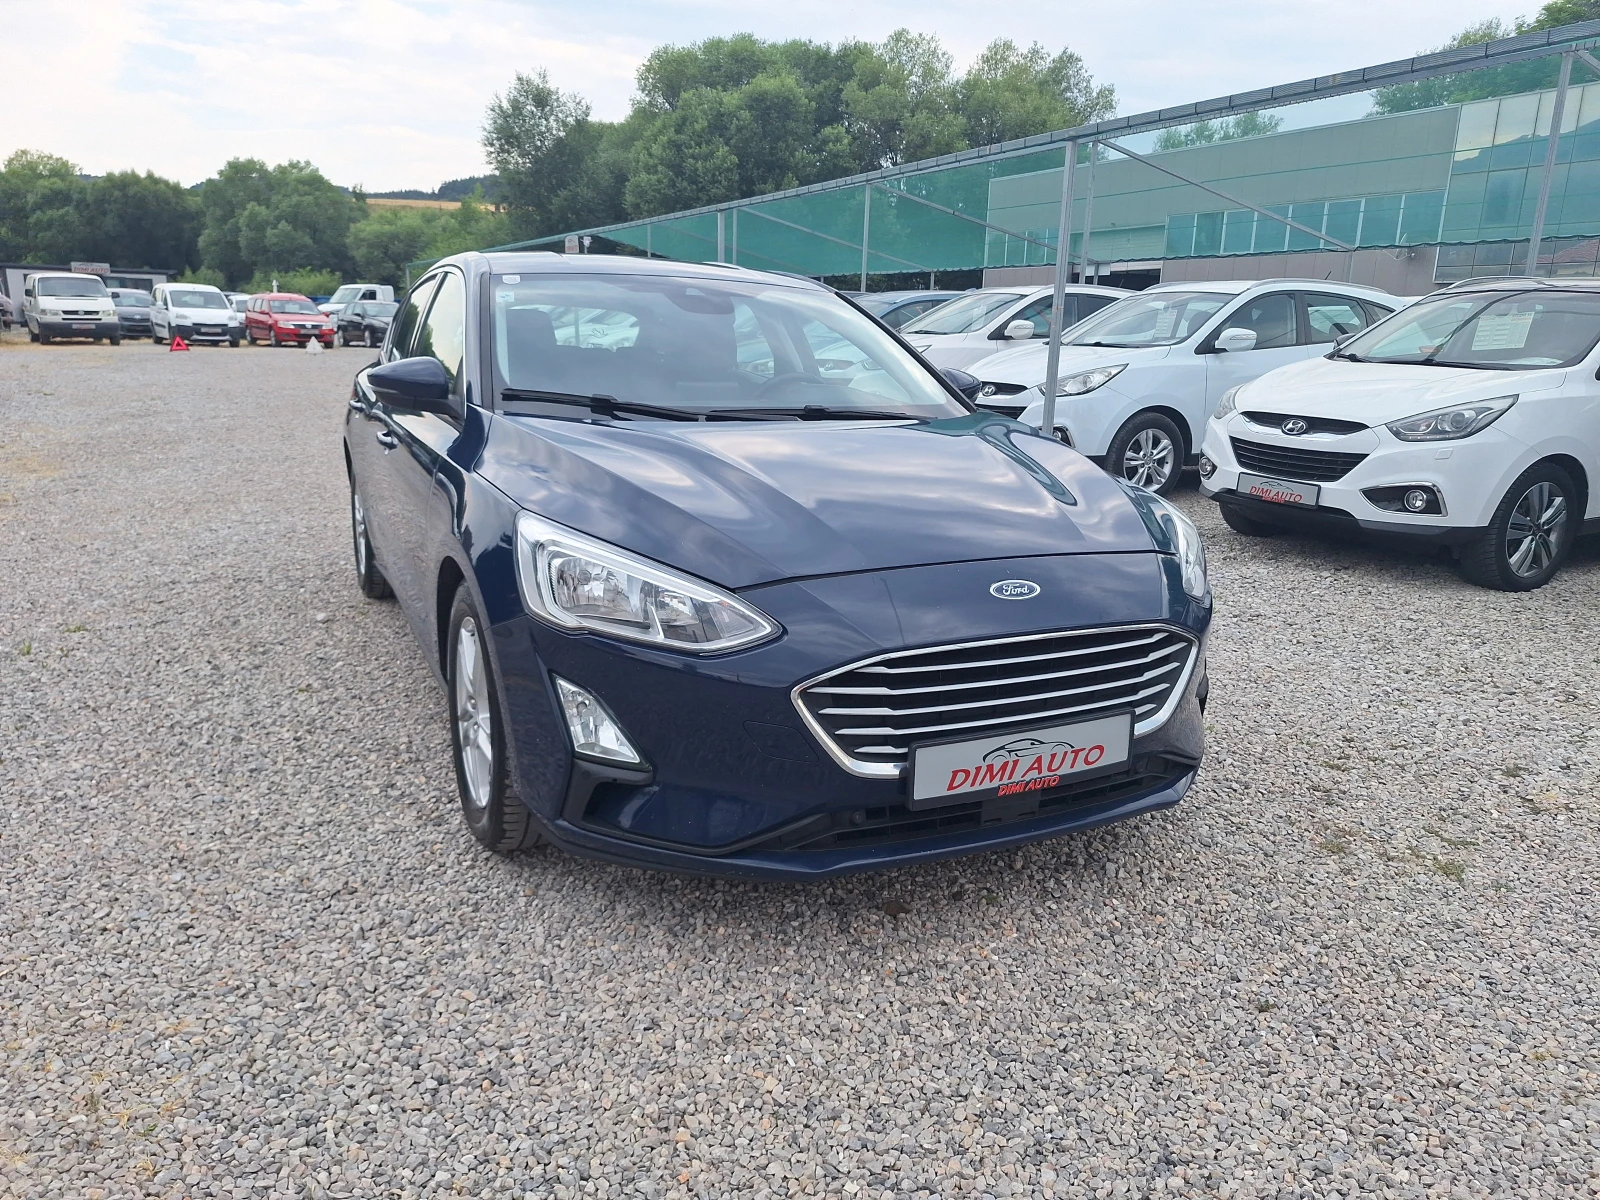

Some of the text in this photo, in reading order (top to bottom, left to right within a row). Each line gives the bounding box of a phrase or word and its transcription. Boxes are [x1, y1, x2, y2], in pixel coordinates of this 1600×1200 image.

[1250, 486, 1272, 496] DIMI
[1273, 491, 1303, 502] AUTO
[1003, 584, 1030, 595] Ford
[946, 744, 1105, 792] DIMI AUTO
[997, 775, 1060, 797] DIMI AUTO
